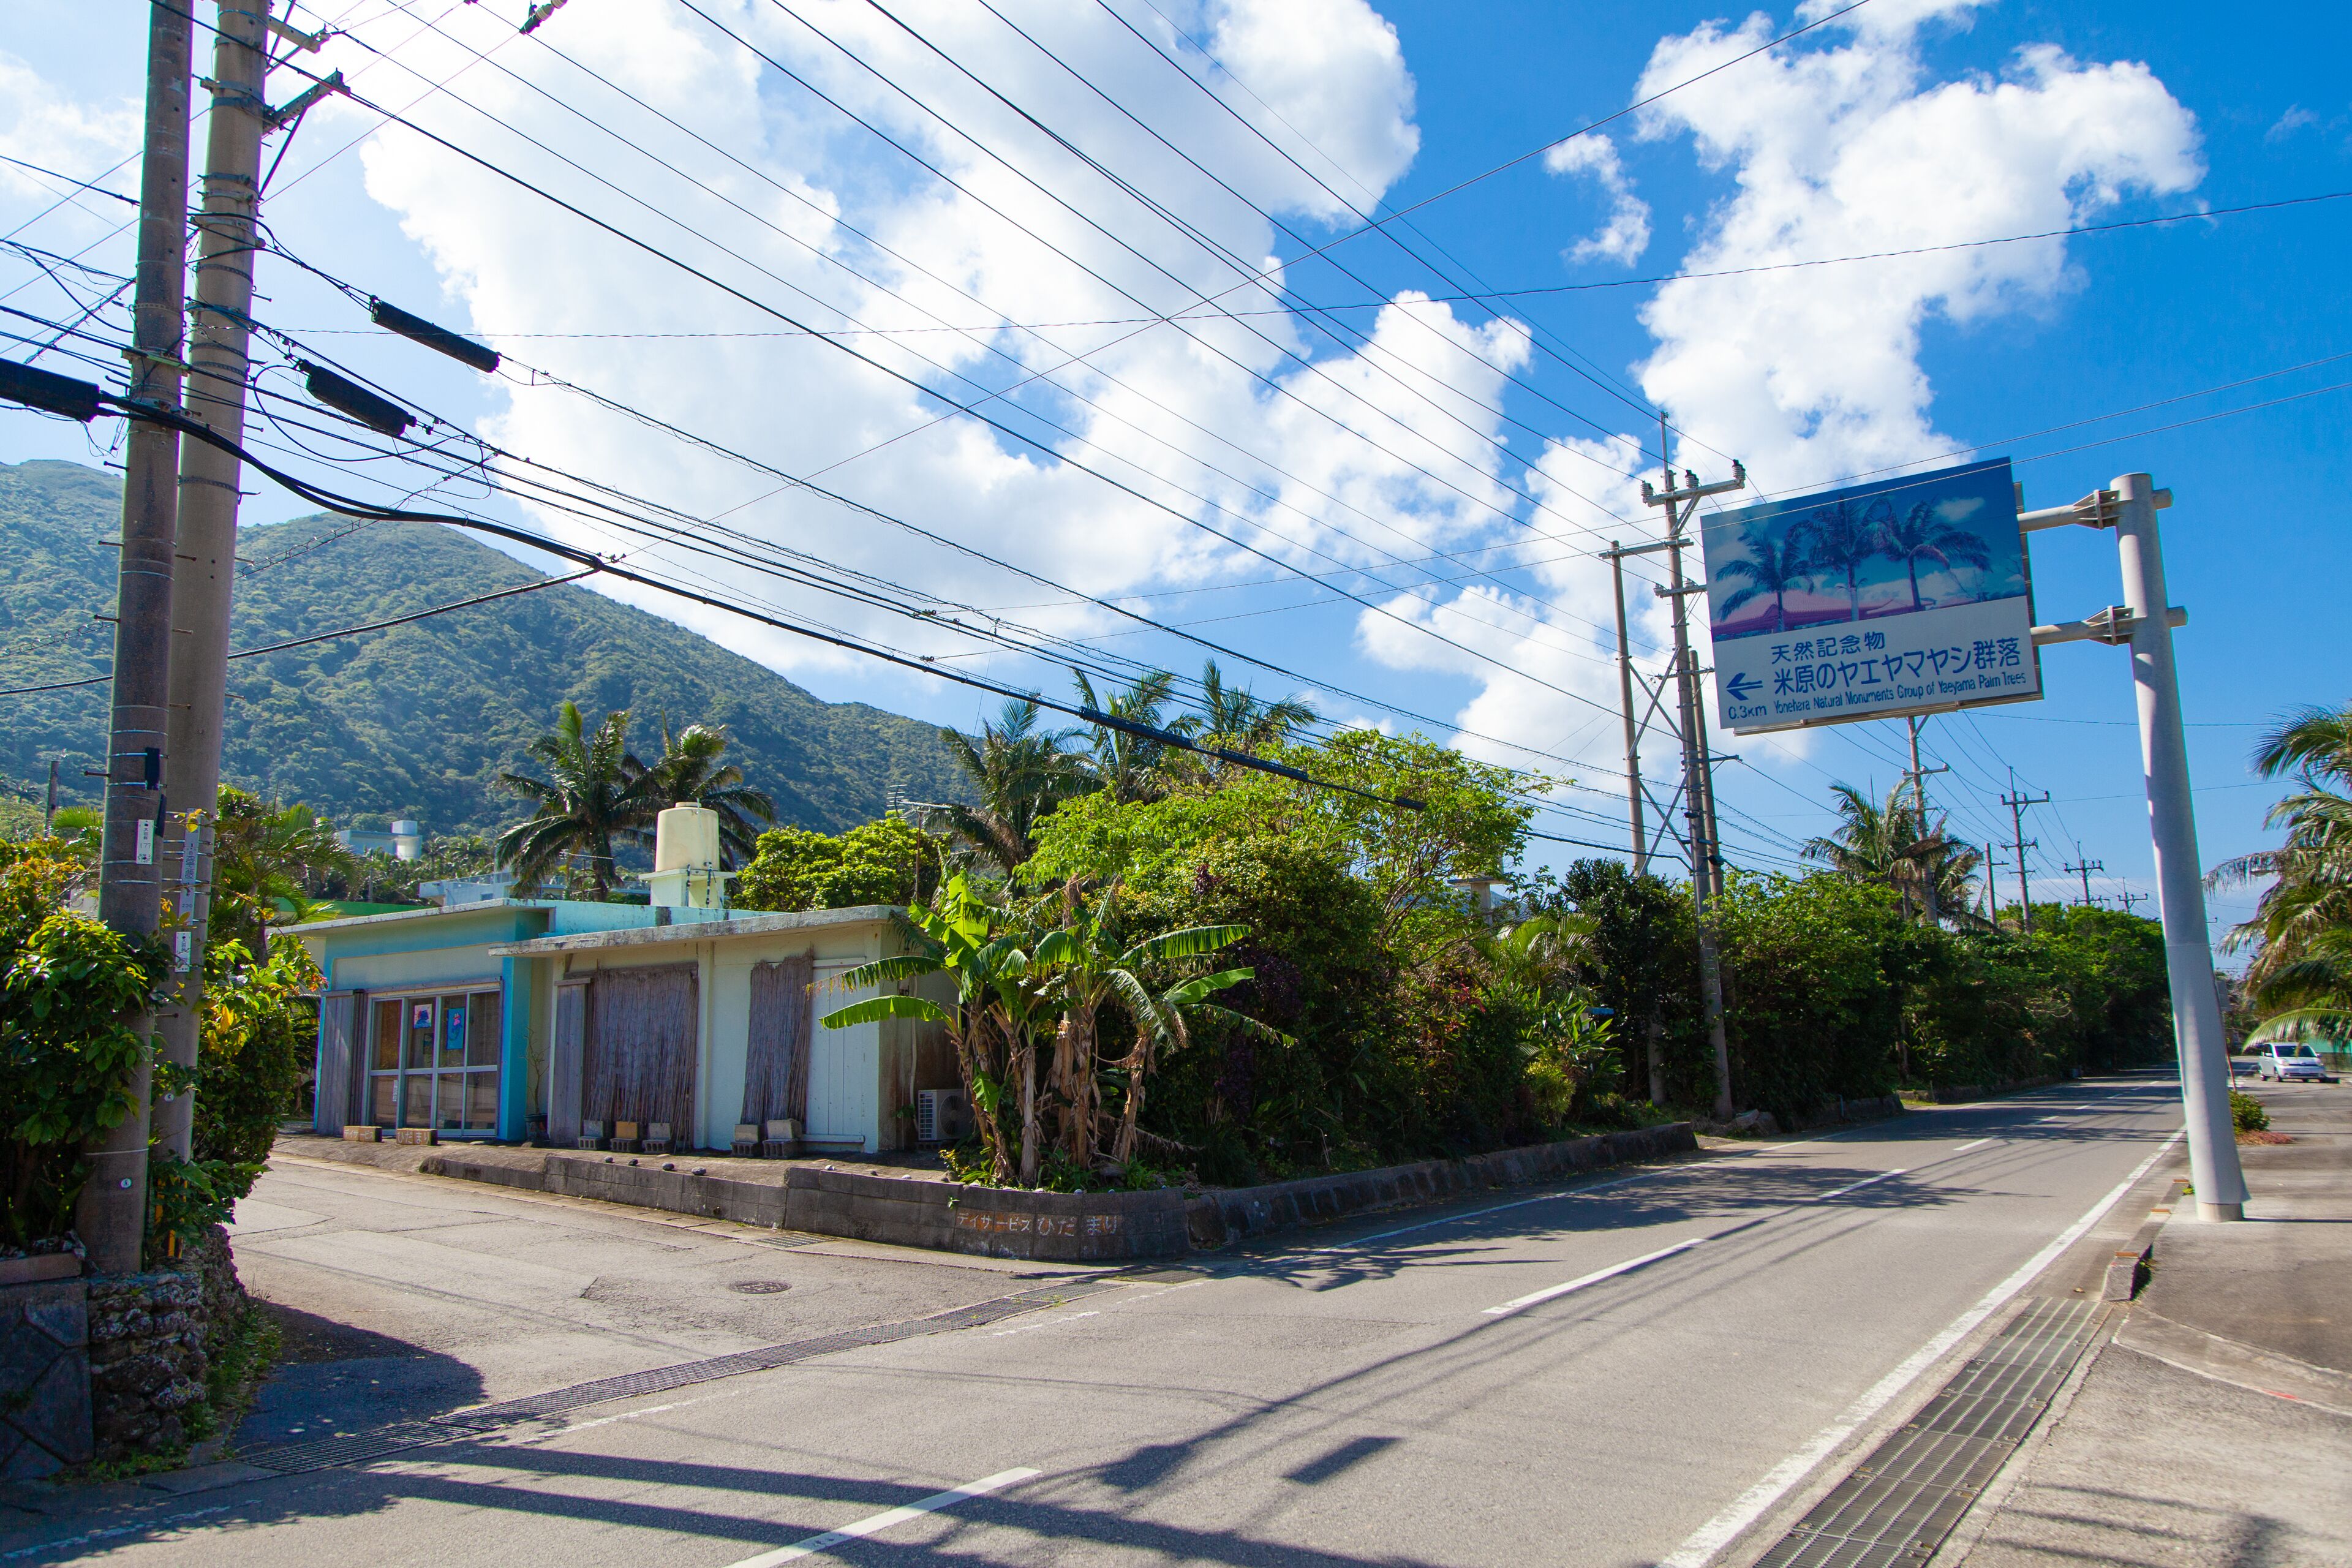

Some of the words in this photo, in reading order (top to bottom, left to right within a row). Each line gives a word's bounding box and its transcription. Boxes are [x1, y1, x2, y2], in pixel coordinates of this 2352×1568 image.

[1771, 631, 1885, 665] 天然記念物
[1774, 637, 2021, 696] 米原のヤエヤマヤシ群落
[1774, 698, 1811, 714] Yonehara
[1814, 693, 1843, 709] Natural
[1845, 687, 1894, 706] Monuments
[1897, 684, 1924, 699] Group
[1926, 682, 1935, 695] of
[1938, 678, 1976, 695] Yaeyama
[1978, 674, 2001, 689] Palm
[2002, 671, 2026, 685] Trees
[1728, 705, 1767, 720] 0.3km
[398, 1131, 430, 1144] ひだまり
